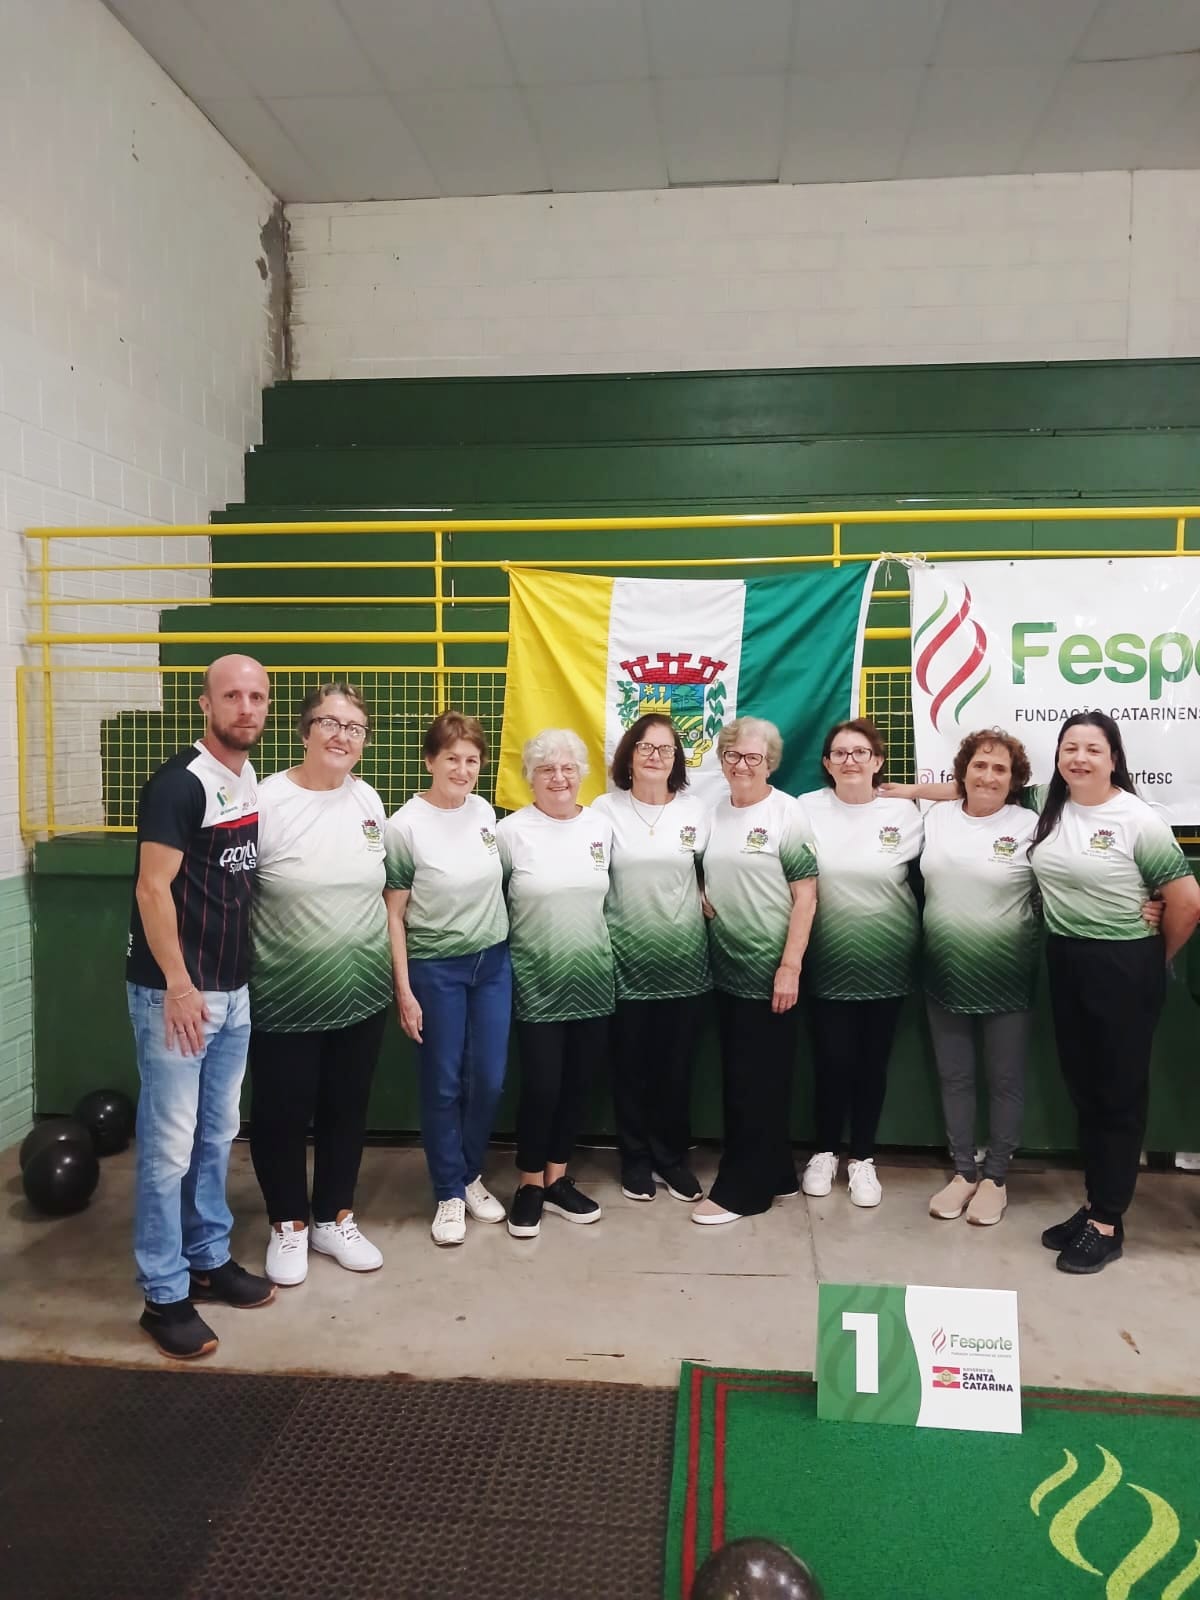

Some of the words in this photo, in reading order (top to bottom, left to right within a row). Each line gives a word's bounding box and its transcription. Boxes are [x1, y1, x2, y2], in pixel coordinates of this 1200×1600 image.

[1012, 622, 1200, 700] Fesp
[950, 1334, 1013, 1352] Fesporte
[842, 1311, 879, 1394] 1
[962, 1373, 996, 1382] SANTA
[962, 1382, 1014, 1392] CATARINA
